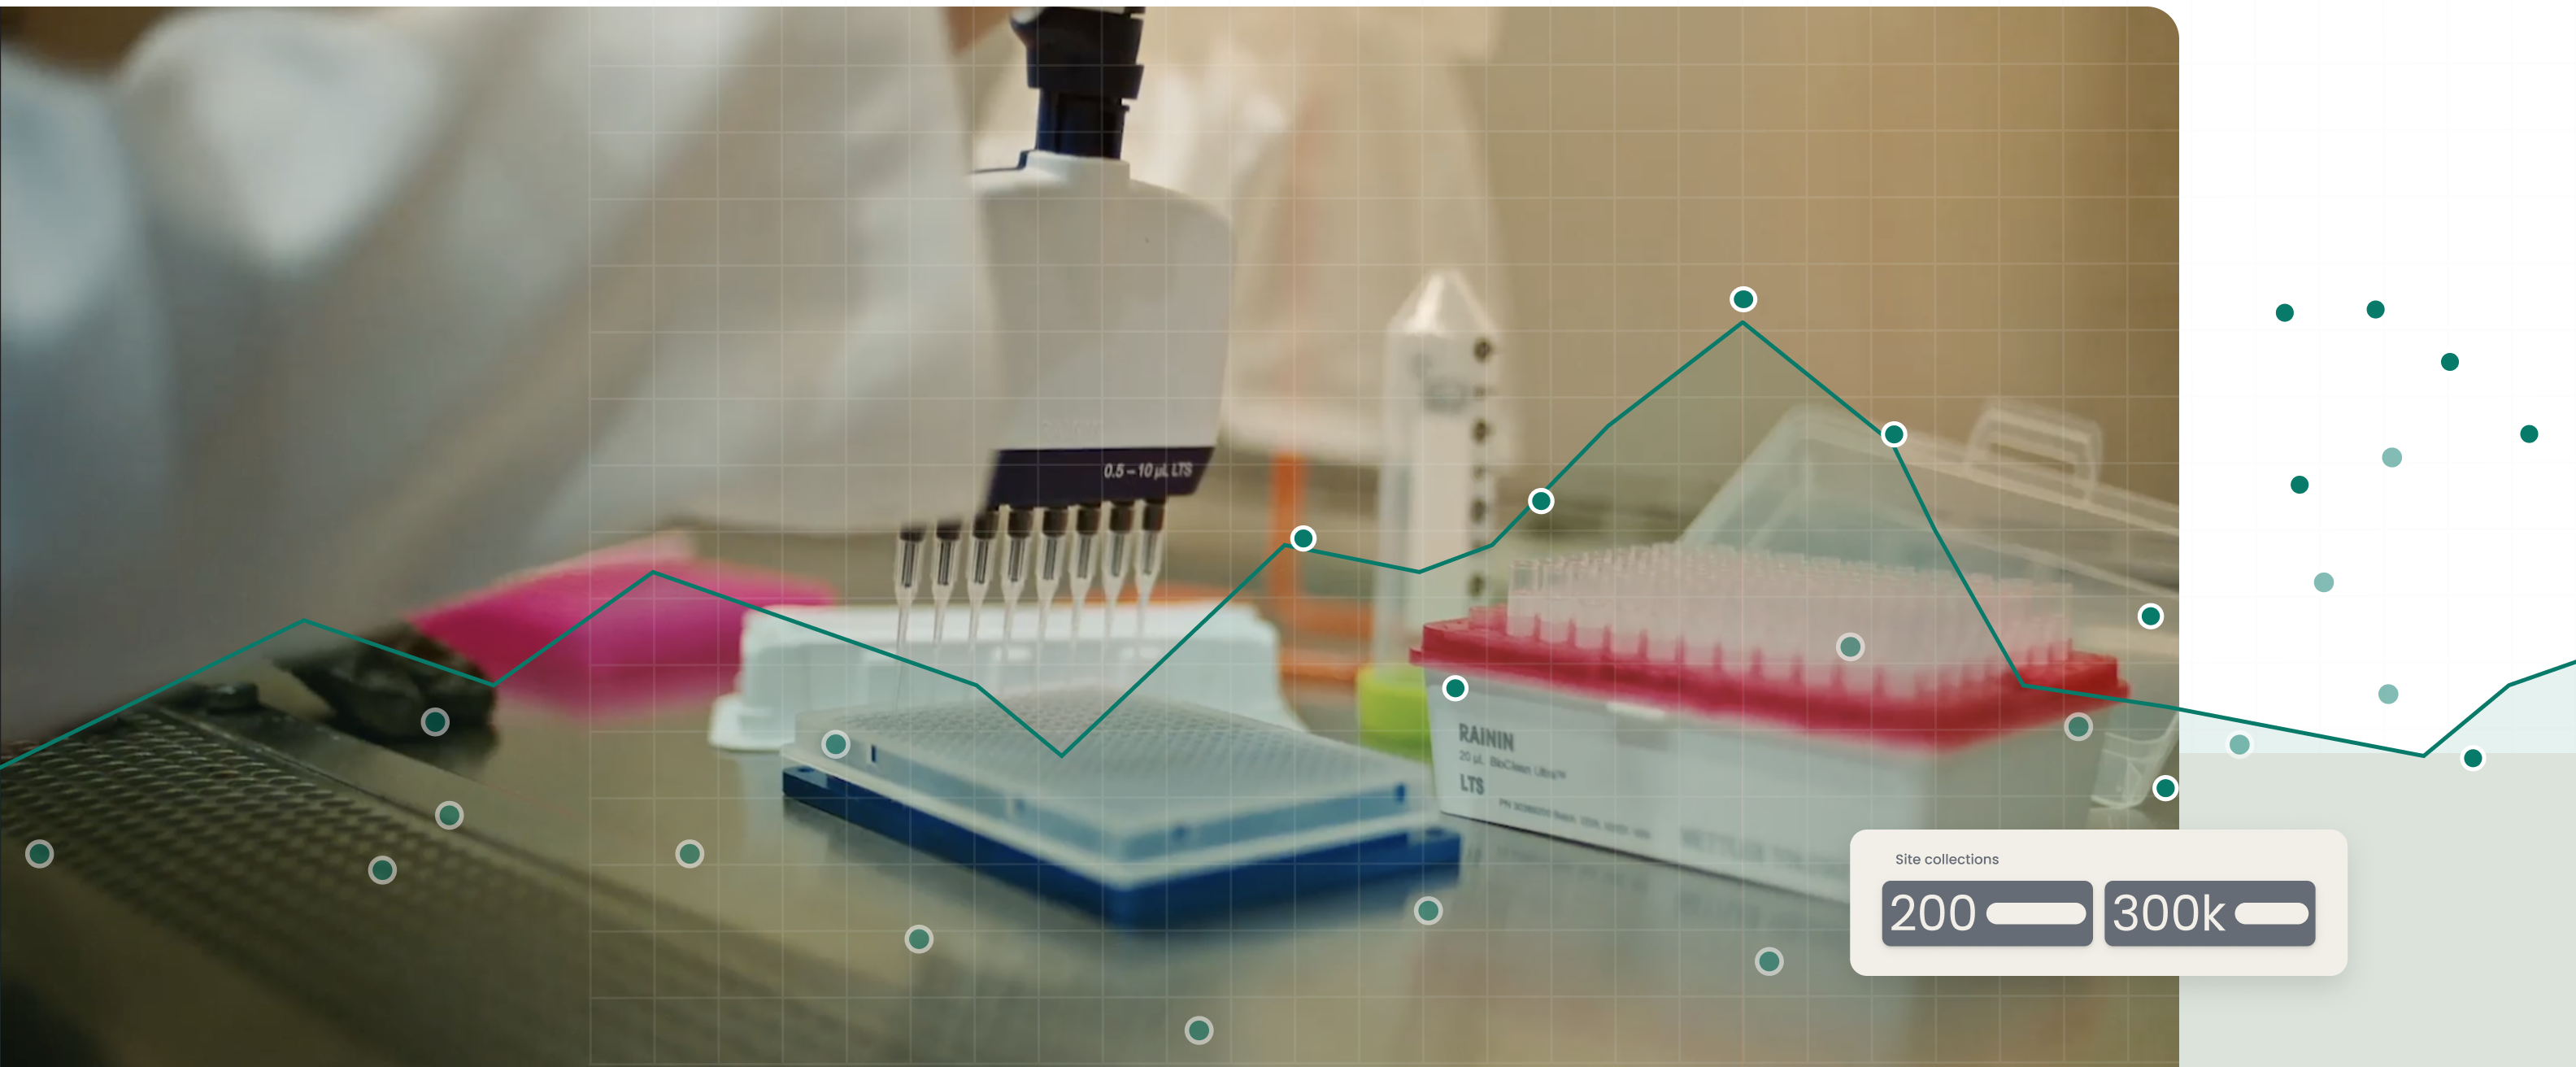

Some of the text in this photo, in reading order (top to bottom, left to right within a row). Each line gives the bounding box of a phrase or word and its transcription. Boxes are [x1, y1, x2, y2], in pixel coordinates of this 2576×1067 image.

[1103, 463, 1125, 478] 0.5
[1138, 463, 1152, 478] 10
[1171, 462, 1193, 477] LTS
[1460, 750, 1471, 761] 20
[1460, 773, 1485, 795] LTS
